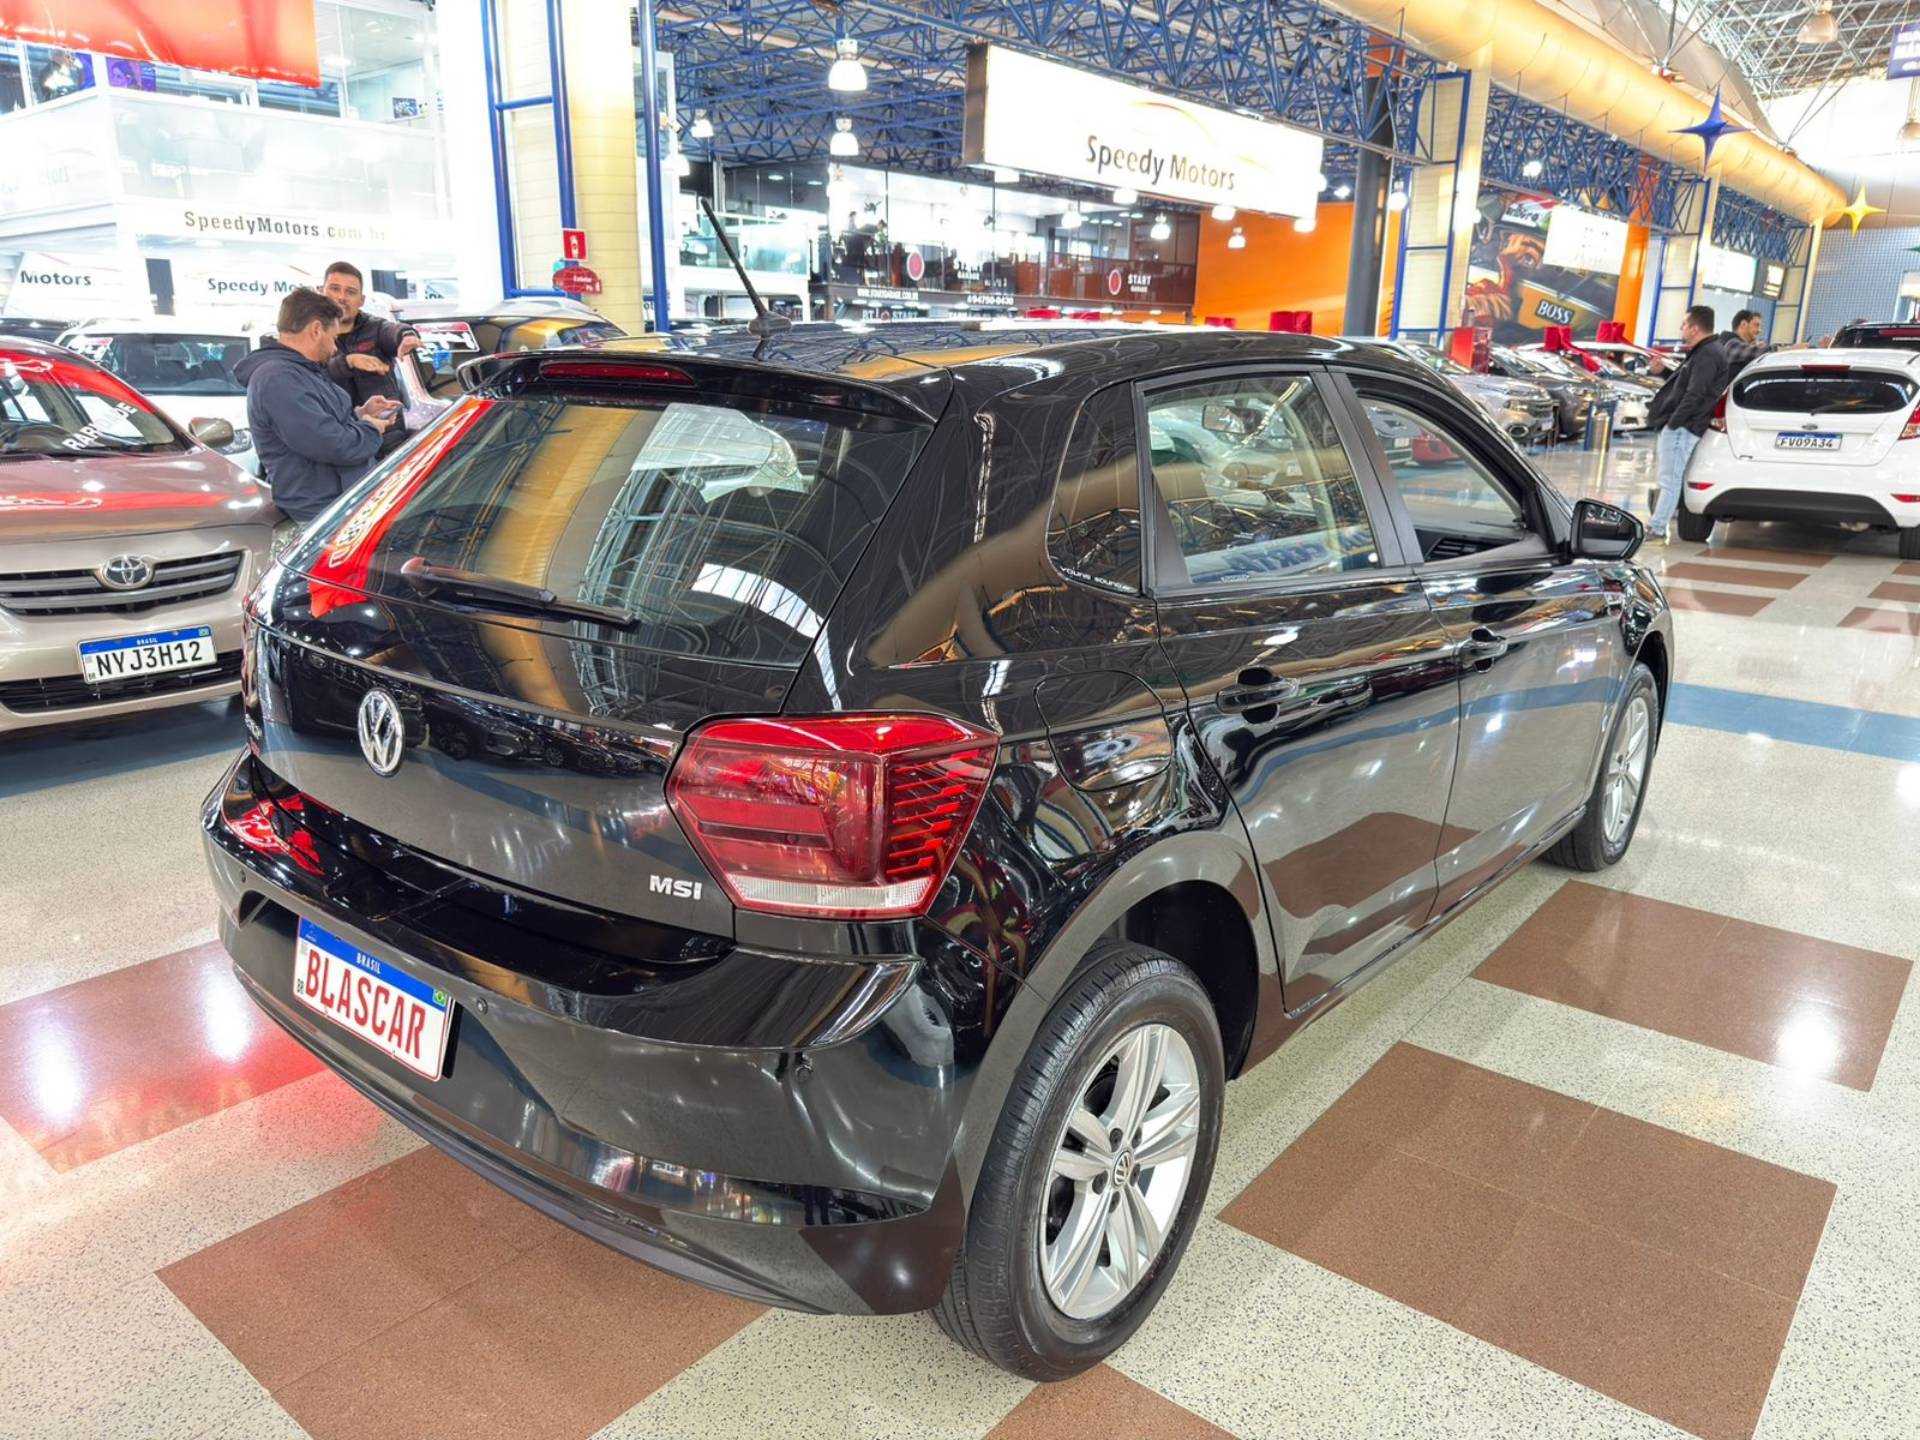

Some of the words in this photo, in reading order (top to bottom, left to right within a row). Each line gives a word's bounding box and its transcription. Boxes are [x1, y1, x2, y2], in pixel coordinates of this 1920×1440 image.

[1086, 134, 1165, 185] Speedy
[1169, 154, 1236, 190] Motors
[20, 270, 92, 286] Motors
[208, 278, 268, 296] Speedy
[1127, 273, 1152, 286] START
[1537, 300, 1573, 325] BOSS
[96, 641, 203, 677] NYJ3H12
[649, 874, 702, 900] MSI
[356, 952, 381, 975] BRASIL
[305, 949, 426, 1059] BLASCAR
